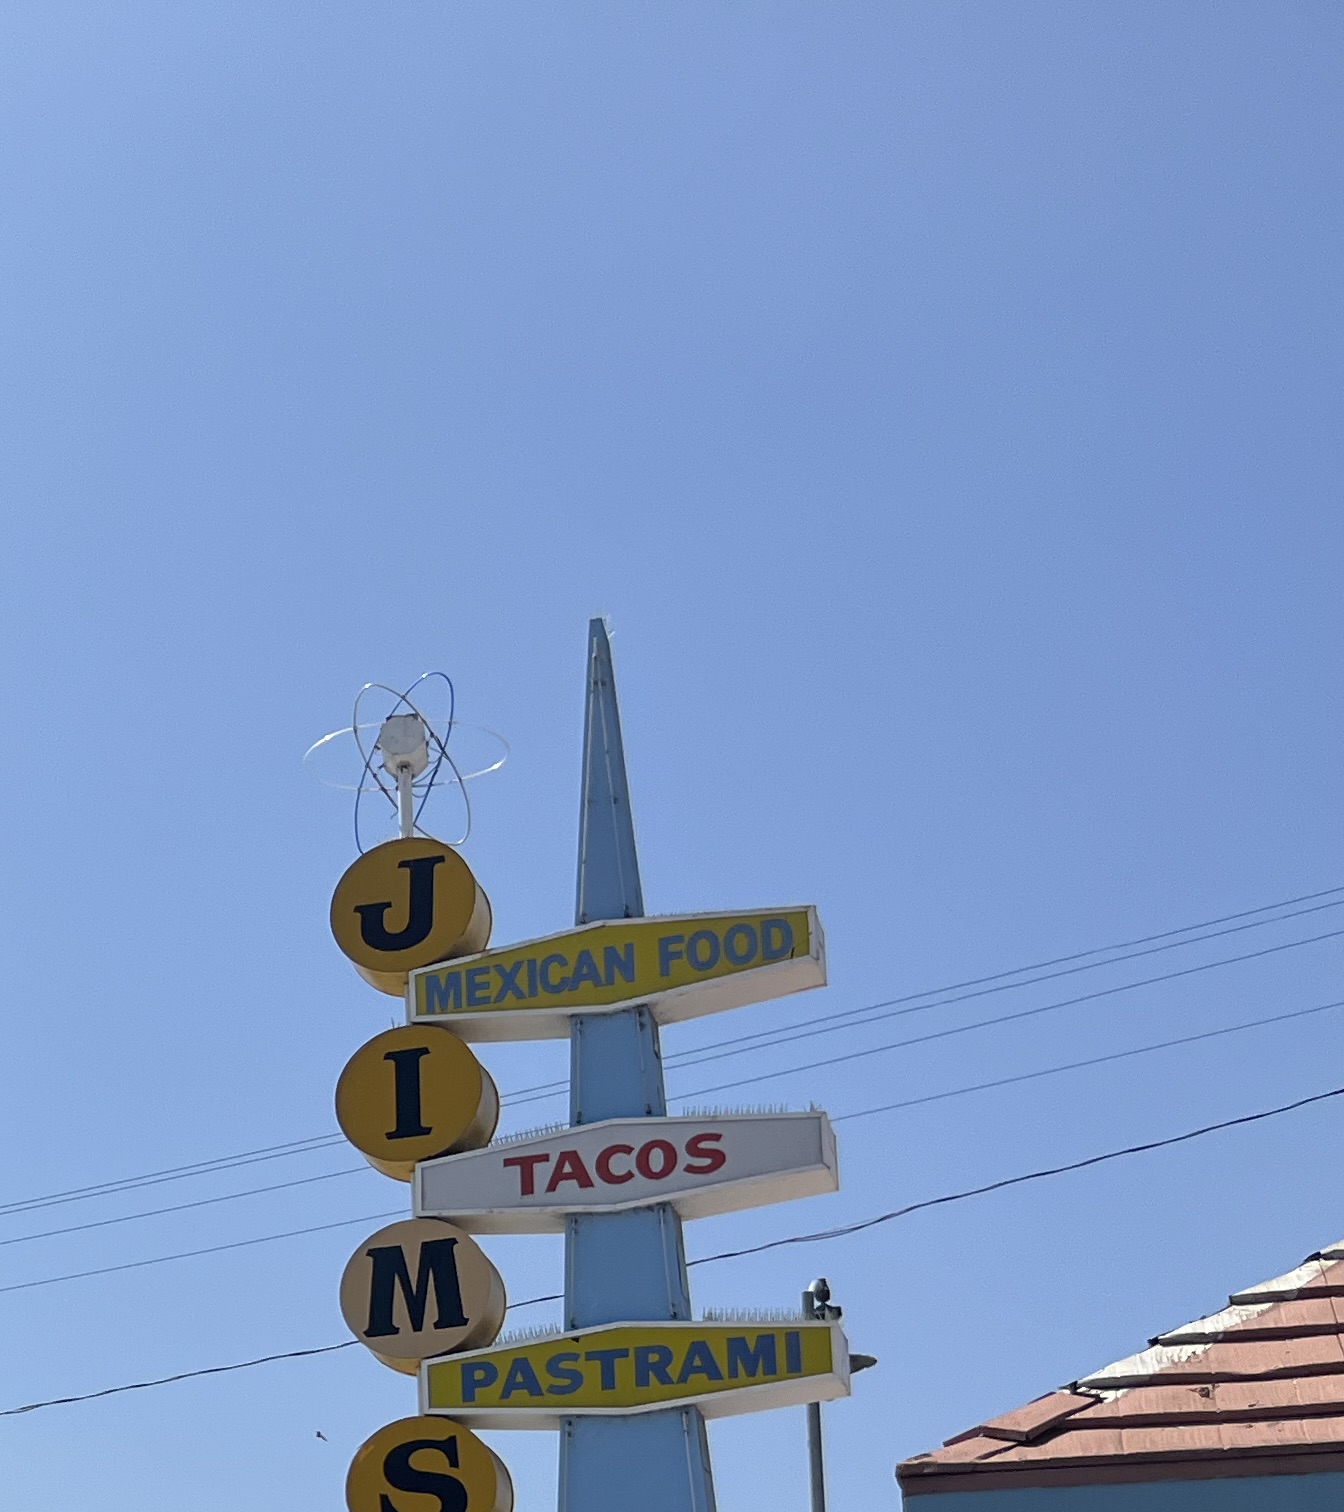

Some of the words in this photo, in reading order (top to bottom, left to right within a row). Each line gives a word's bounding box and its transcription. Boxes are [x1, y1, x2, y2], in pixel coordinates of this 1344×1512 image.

[423, 941, 636, 1015] MEXICAN
[657, 918, 794, 977] FOOD
[502, 1132, 727, 1196] TACOS
[459, 1330, 803, 1403] PASTRAMI
